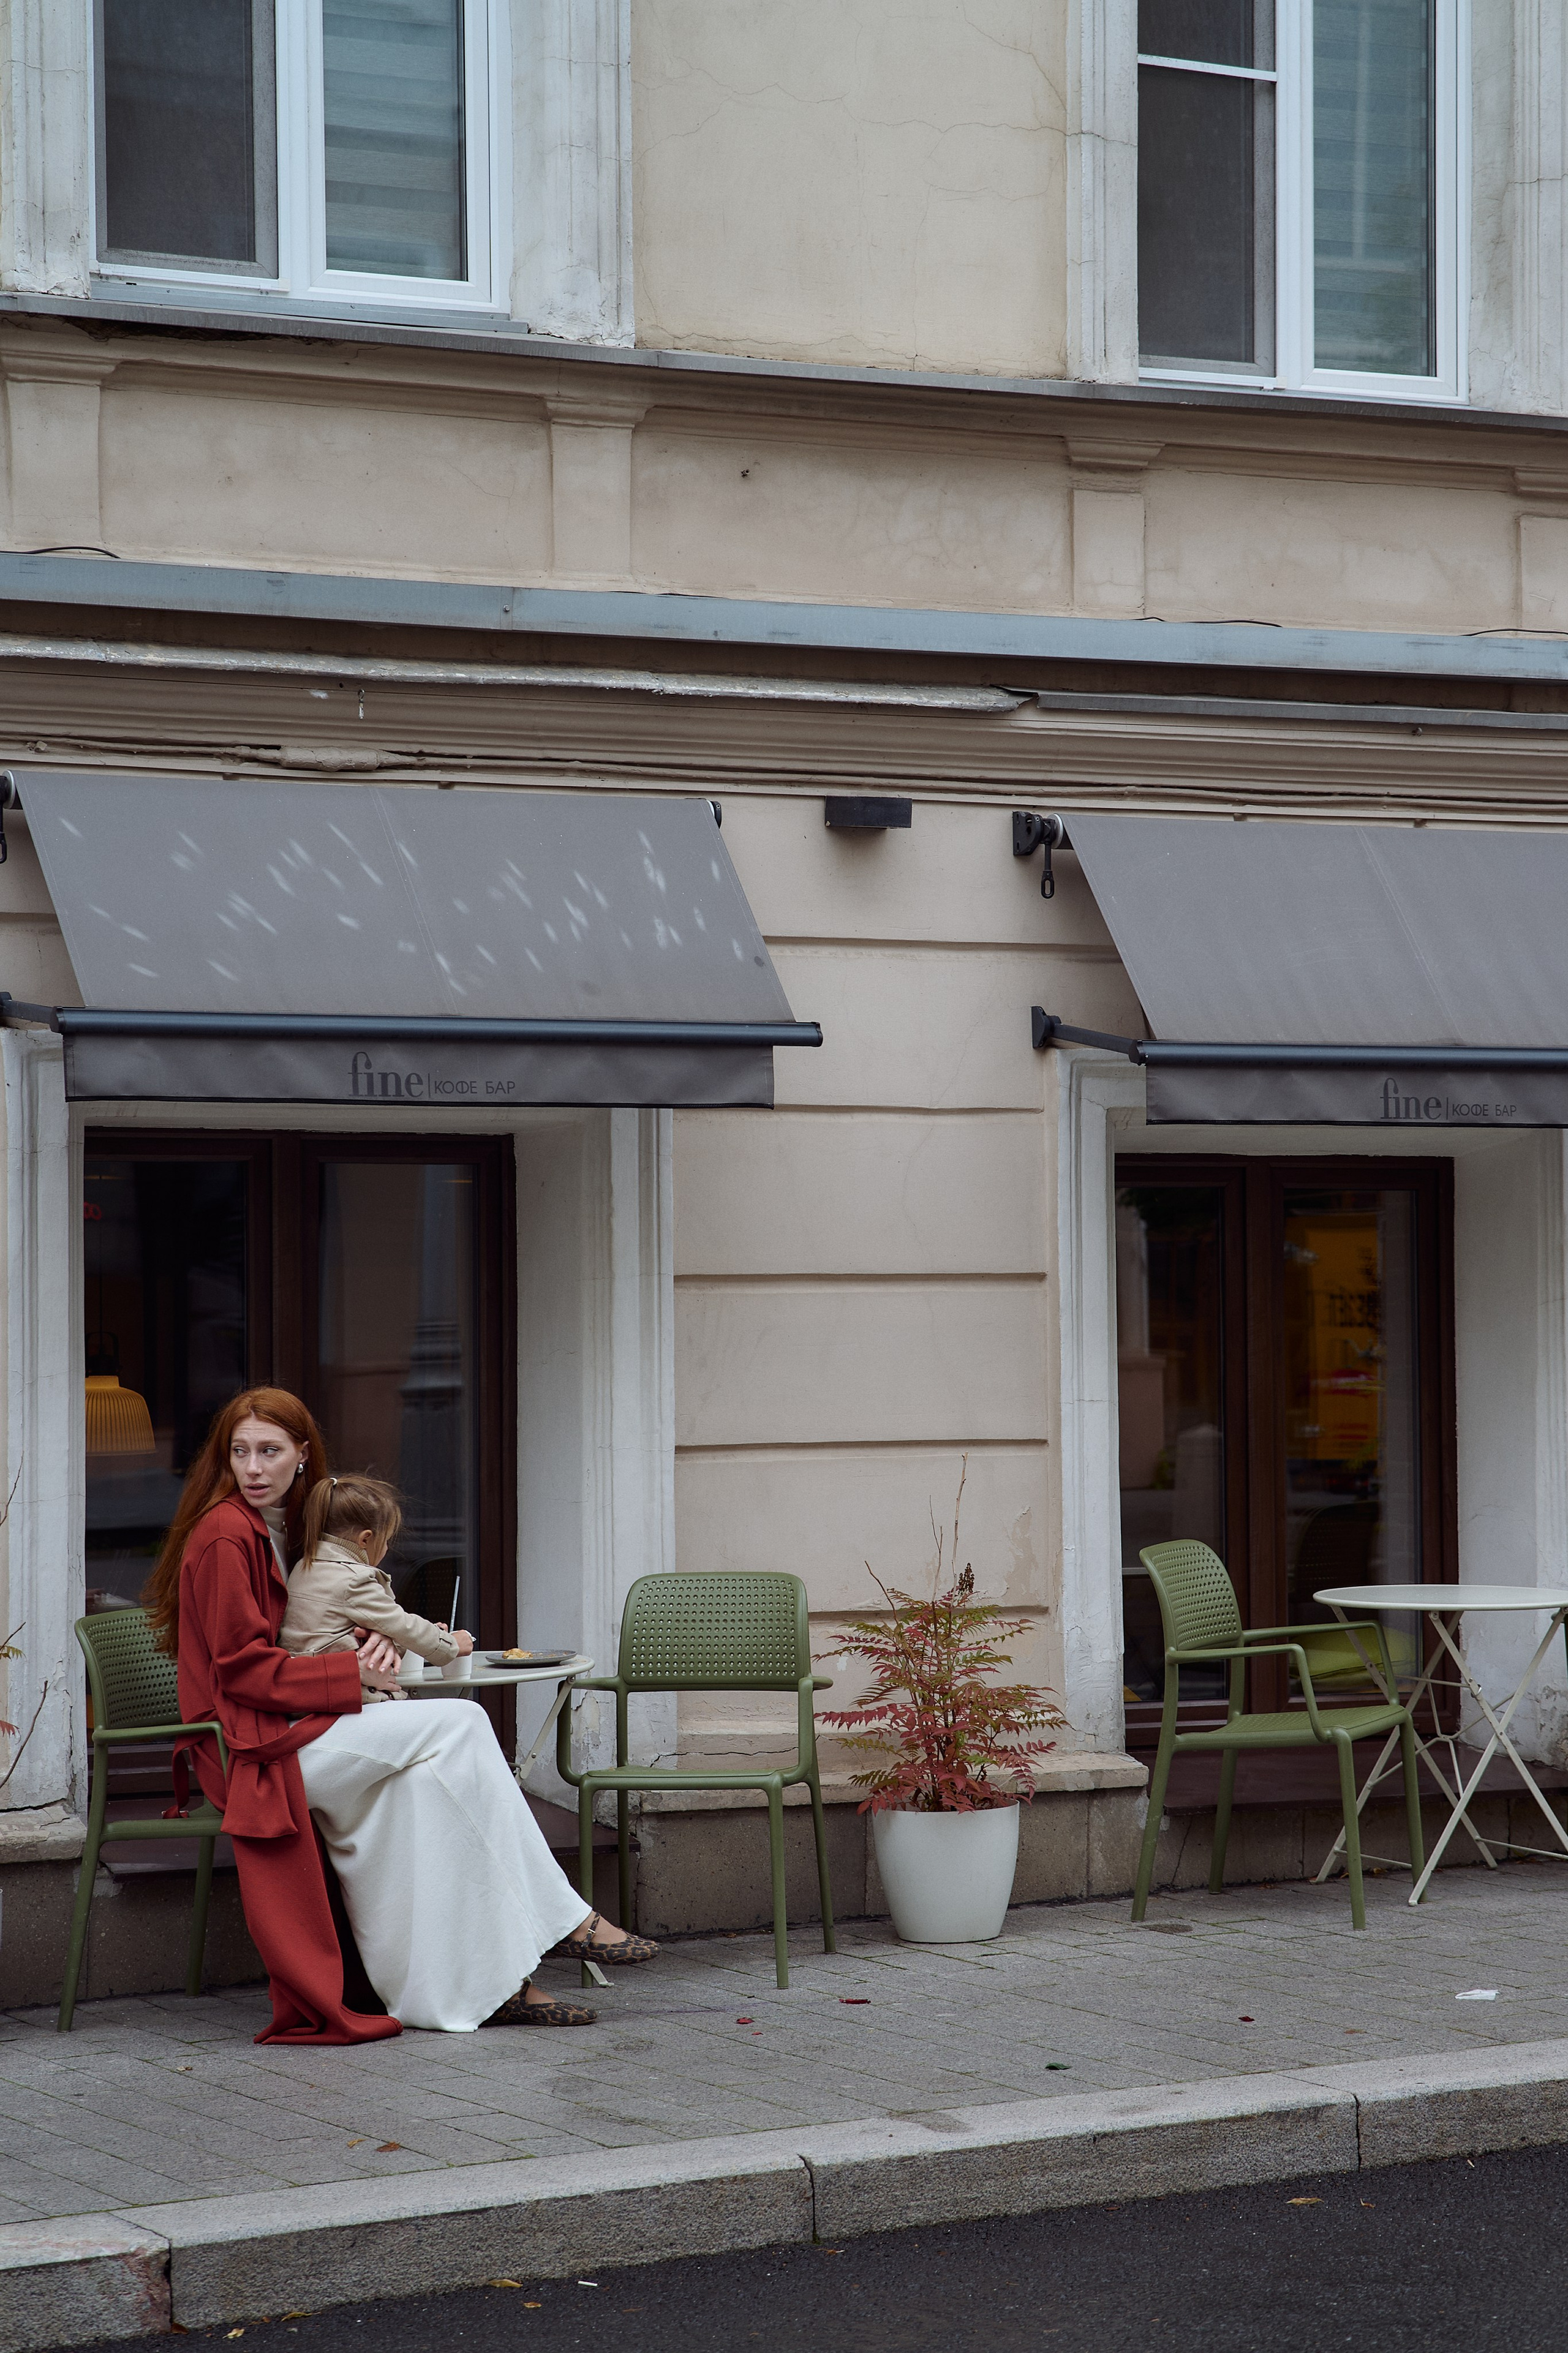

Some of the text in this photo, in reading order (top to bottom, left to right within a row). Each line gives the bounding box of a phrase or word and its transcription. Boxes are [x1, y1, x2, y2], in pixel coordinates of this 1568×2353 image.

[348, 1052, 424, 1097] fine
[434, 1080, 516, 1094] КОФЕ БАР
[1380, 1077, 1442, 1120] fine
[1452, 1104, 1517, 1117] КОФЕ БАР
